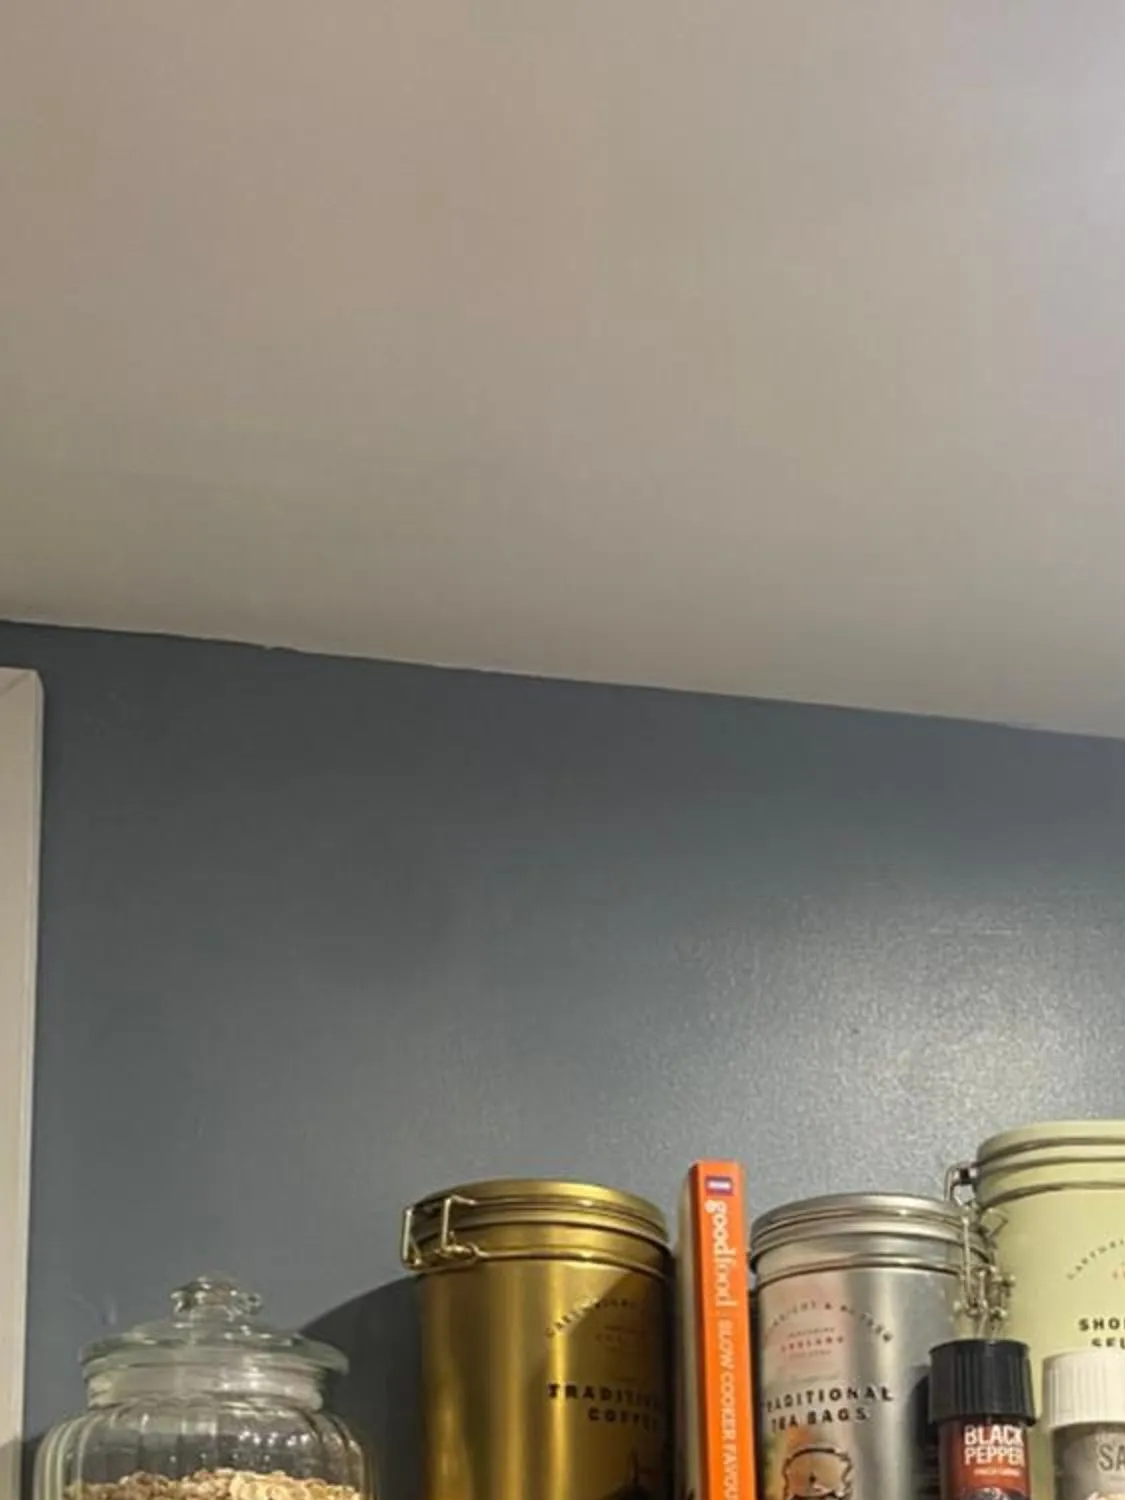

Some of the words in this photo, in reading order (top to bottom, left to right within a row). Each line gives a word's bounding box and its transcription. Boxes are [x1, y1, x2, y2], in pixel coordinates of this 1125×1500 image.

[705, 1200, 738, 1307] goodfood
[718, 1320, 735, 1367] SLOW
[721, 1372, 738, 1440] COOKER
[767, 1385, 894, 1412] RADITIONAL
[807, 1407, 871, 1425] BAGS
[964, 1424, 1024, 1446] BLACK
[964, 1446, 1026, 1466] PEPPER
